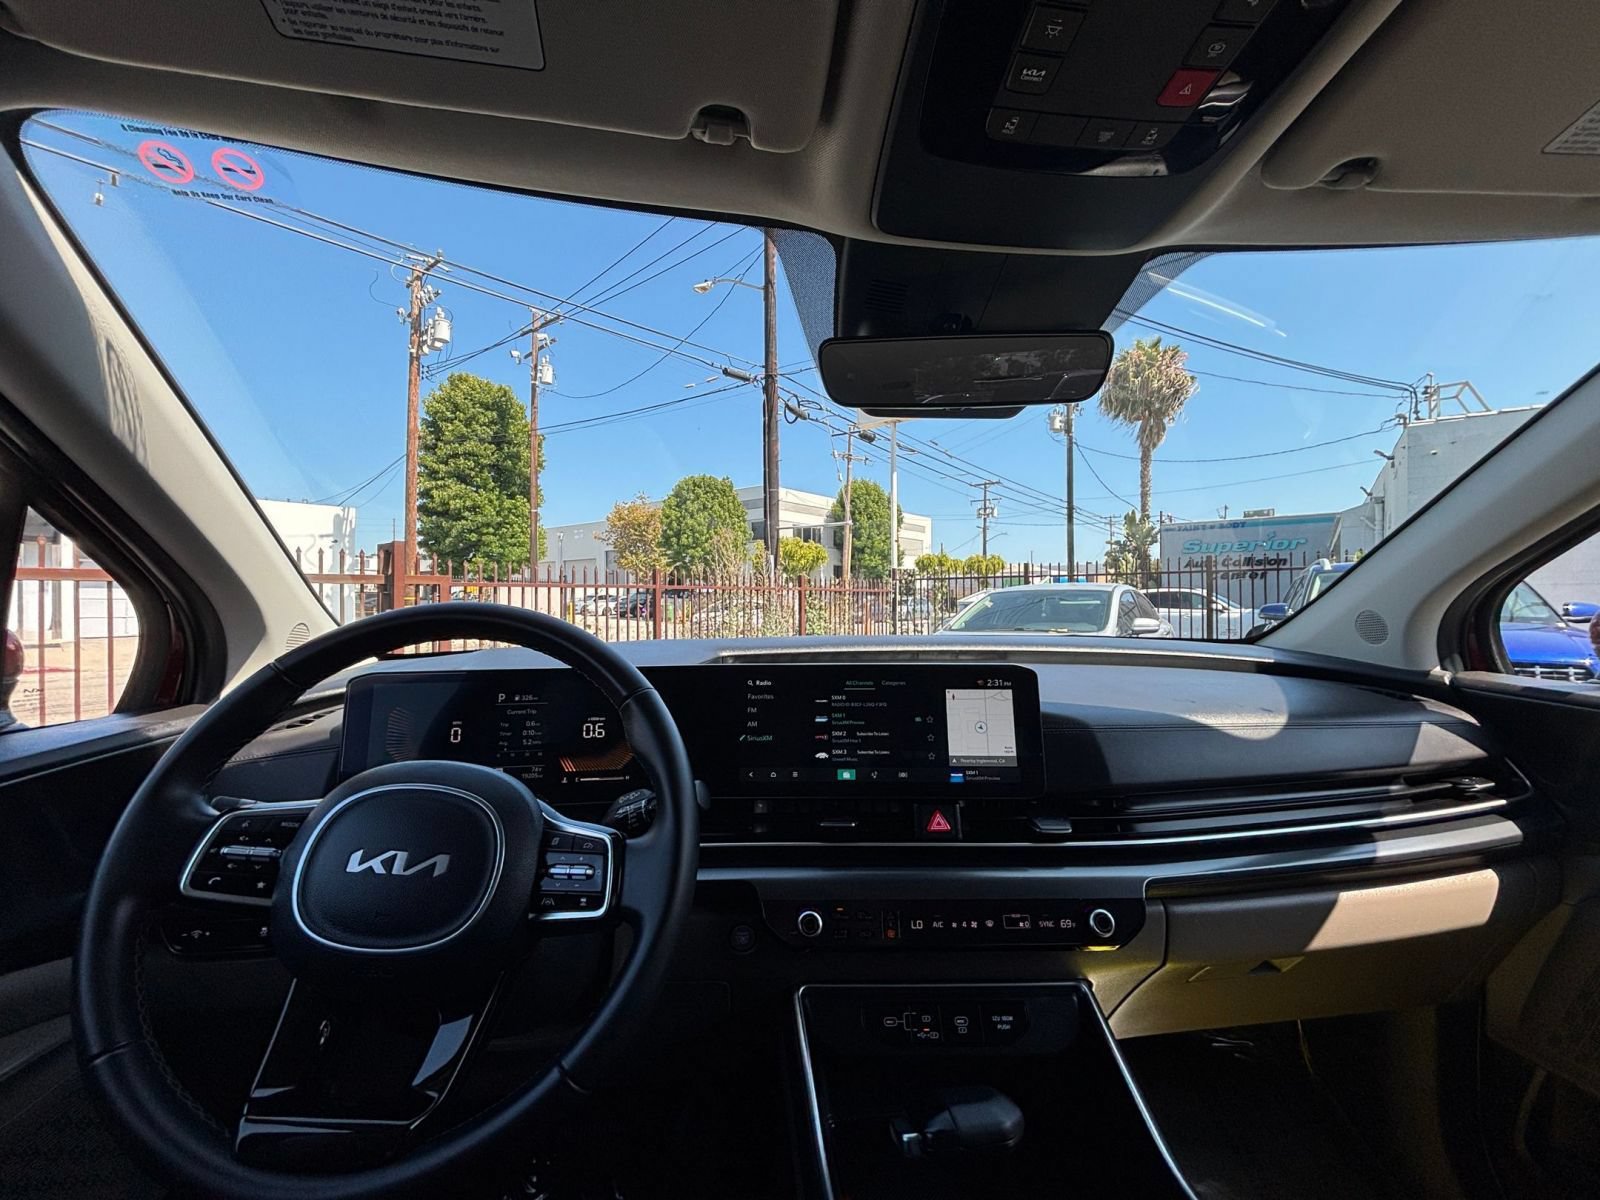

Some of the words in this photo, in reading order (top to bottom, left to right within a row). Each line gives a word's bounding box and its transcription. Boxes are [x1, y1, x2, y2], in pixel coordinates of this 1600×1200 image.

[171, 188, 187, 197] Help
[200, 191, 219, 201] Keep
[253, 196, 273, 204] Clean
[1182, 536, 1308, 556] Superior
[1221, 556, 1288, 568] Collision
[987, 679, 1003, 687] 2:31
[498, 693, 506, 701] P
[450, 727, 462, 742] 0
[583, 723, 606, 738] 0.6
[747, 734, 773, 742] SiriusXM
[345, 849, 450, 878] KIA
[1038, 920, 1055, 928] SYNC
